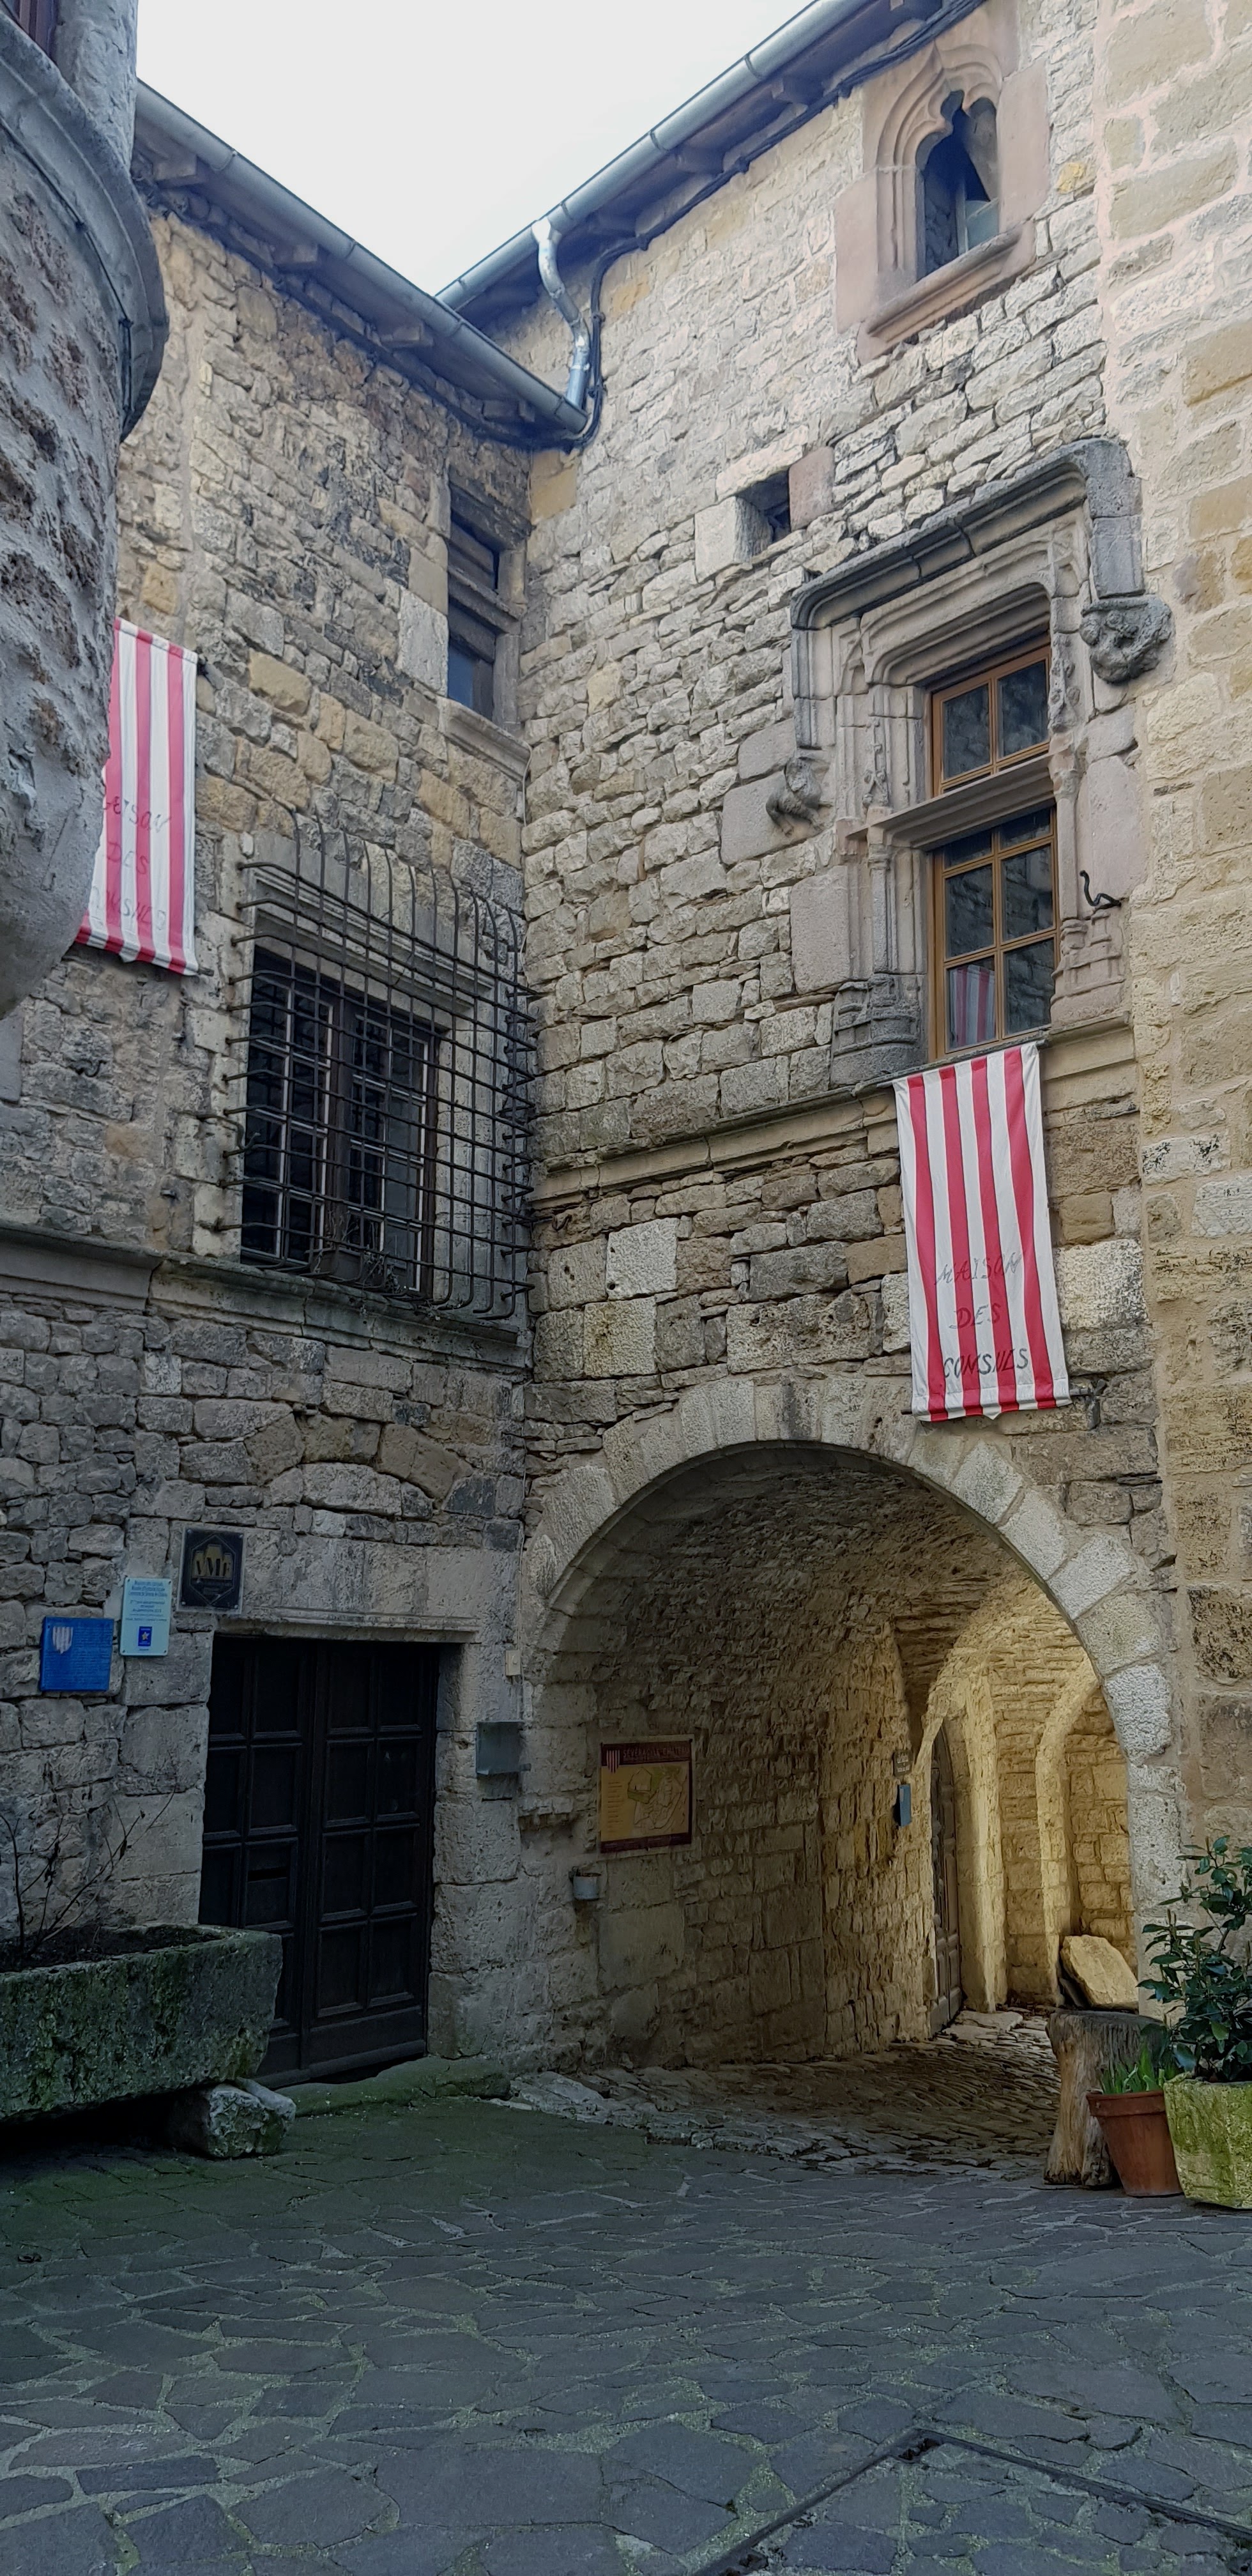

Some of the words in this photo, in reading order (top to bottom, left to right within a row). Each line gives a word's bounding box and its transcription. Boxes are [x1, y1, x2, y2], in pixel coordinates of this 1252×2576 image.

[103, 795, 172, 833] AISON
[935, 1252, 1022, 1285] MAISON
[949, 1303, 1002, 1330] DES
[943, 1347, 1028, 1379] CONSULS
